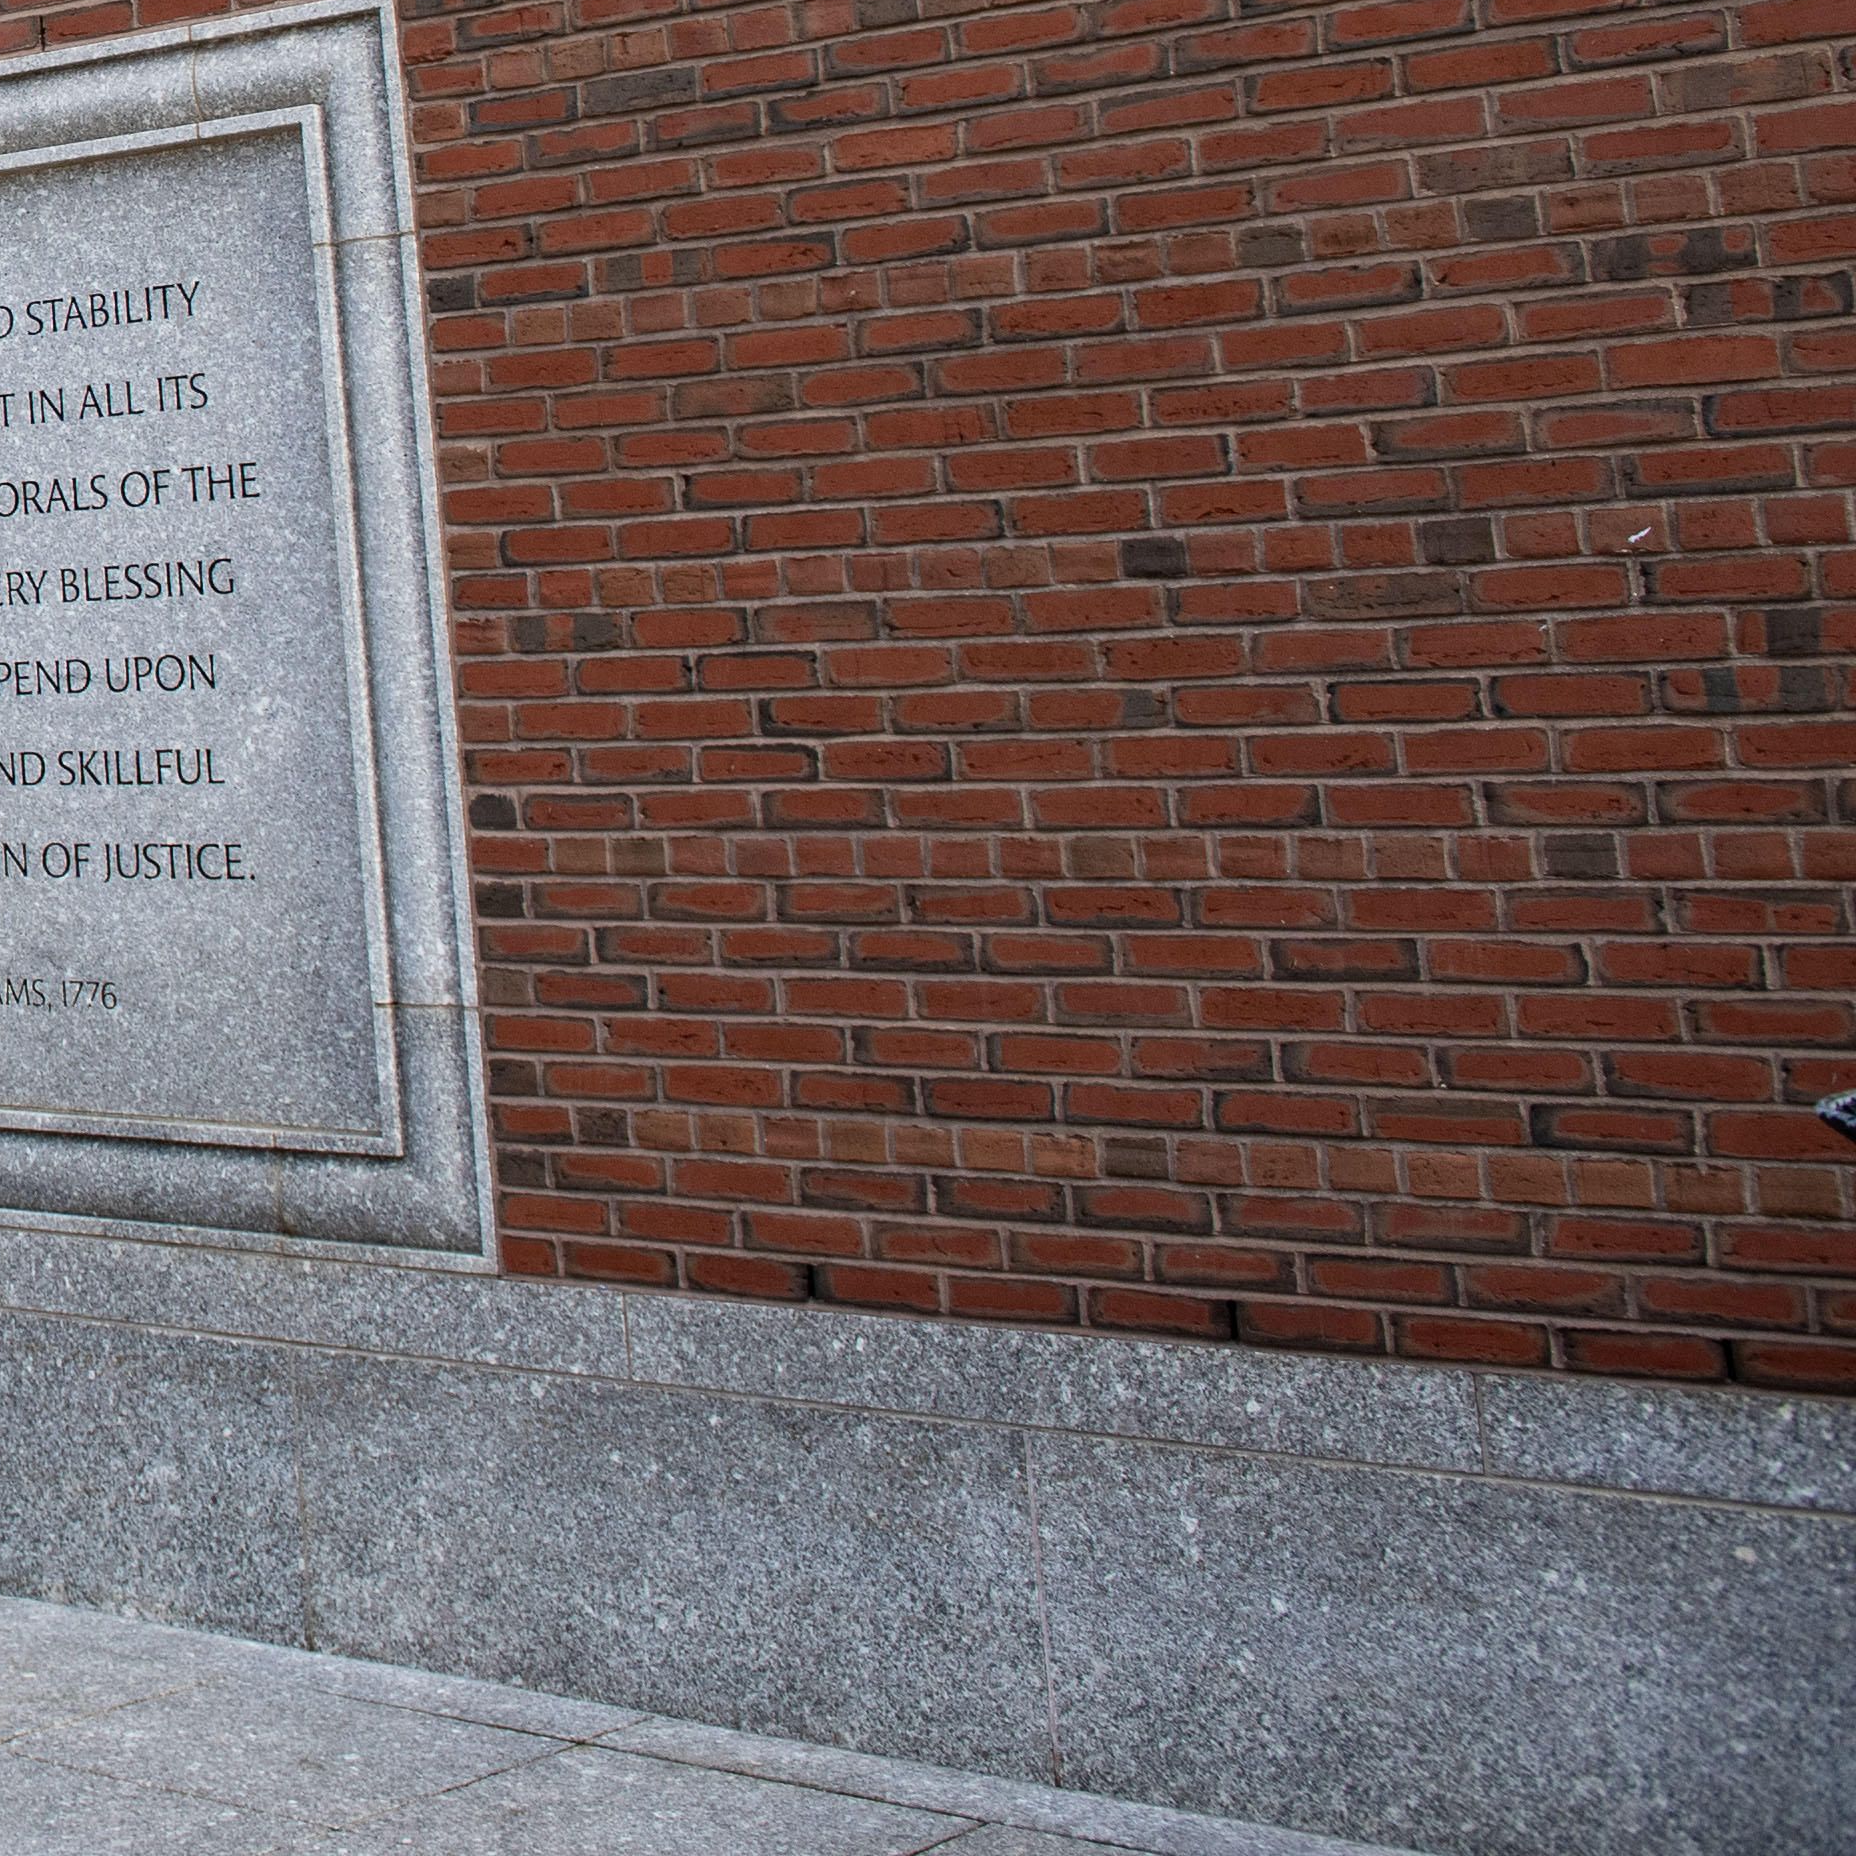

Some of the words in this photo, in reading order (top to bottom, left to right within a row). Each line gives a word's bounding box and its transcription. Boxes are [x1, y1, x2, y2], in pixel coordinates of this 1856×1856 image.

[25, 281, 201, 336] STABILITY
[28, 387, 66, 425] IN
[79, 380, 146, 421] ALL
[156, 372, 209, 411] ITS
[120, 469, 171, 508] OF
[181, 461, 261, 503] THE
[61, 557, 235, 604] BLESSING
[104, 653, 217, 692] UPON
[59, 748, 225, 787] SKILLFUL
[42, 842, 91, 880] OF
[103, 842, 257, 883] JUSTICE.
[60, 978, 118, 1011] 1776
